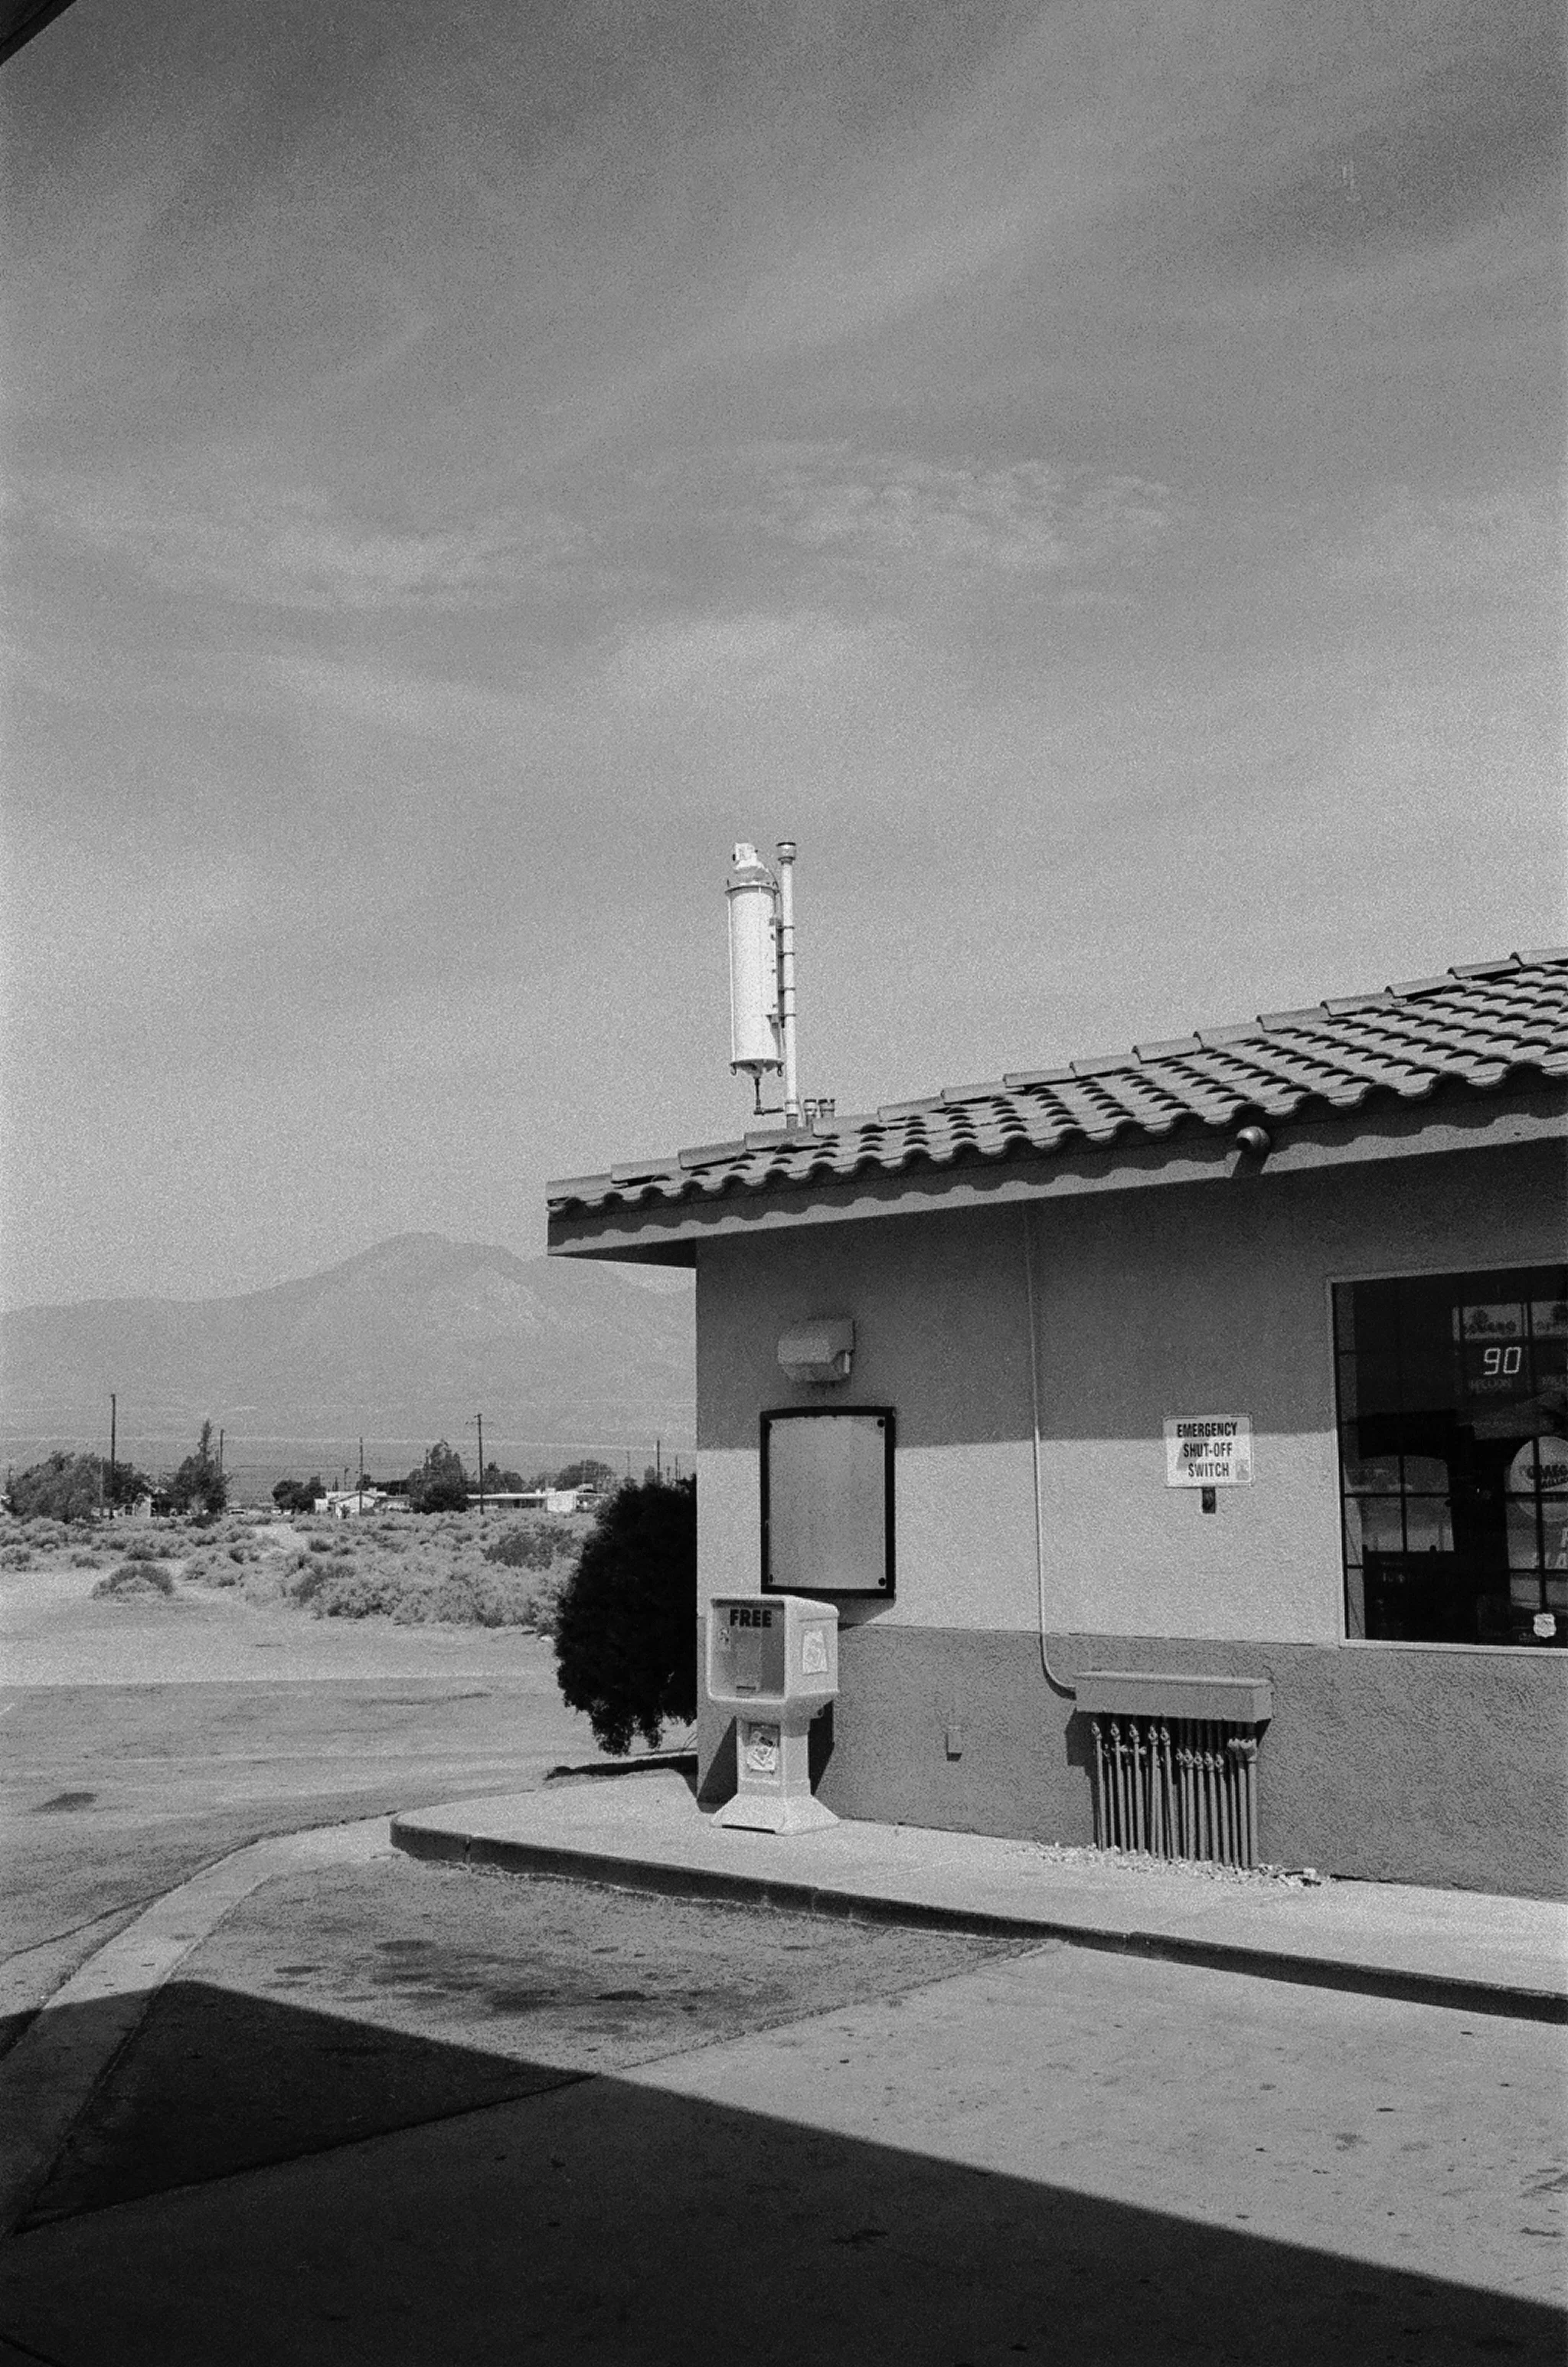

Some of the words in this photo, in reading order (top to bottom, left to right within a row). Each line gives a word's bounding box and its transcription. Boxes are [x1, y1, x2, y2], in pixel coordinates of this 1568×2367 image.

[1483, 1345, 1522, 1375] 90
[1177, 1421, 1237, 1437] EMERGENCY
[1183, 1443, 1232, 1457] SHUT-OFF
[1188, 1463, 1230, 1477] SWITCH
[730, 1609, 772, 1627] FREE
